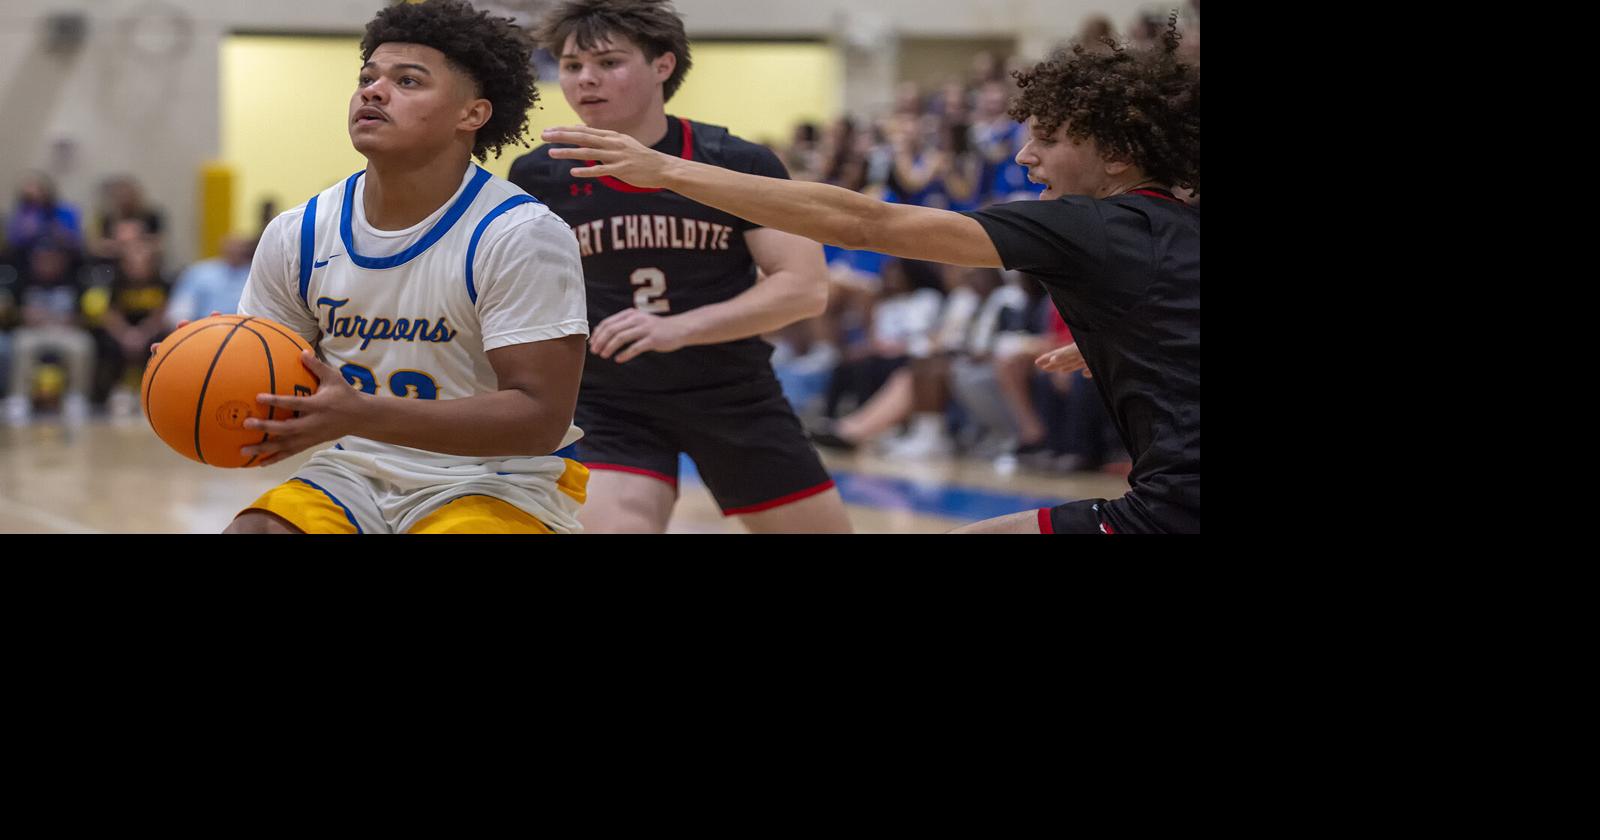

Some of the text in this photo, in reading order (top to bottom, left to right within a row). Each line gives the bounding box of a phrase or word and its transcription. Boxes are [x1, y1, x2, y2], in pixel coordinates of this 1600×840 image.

[573, 214, 734, 257] RT CHARLOTTE
[630, 268, 671, 314] 2
[317, 297, 457, 350] Tarpons
